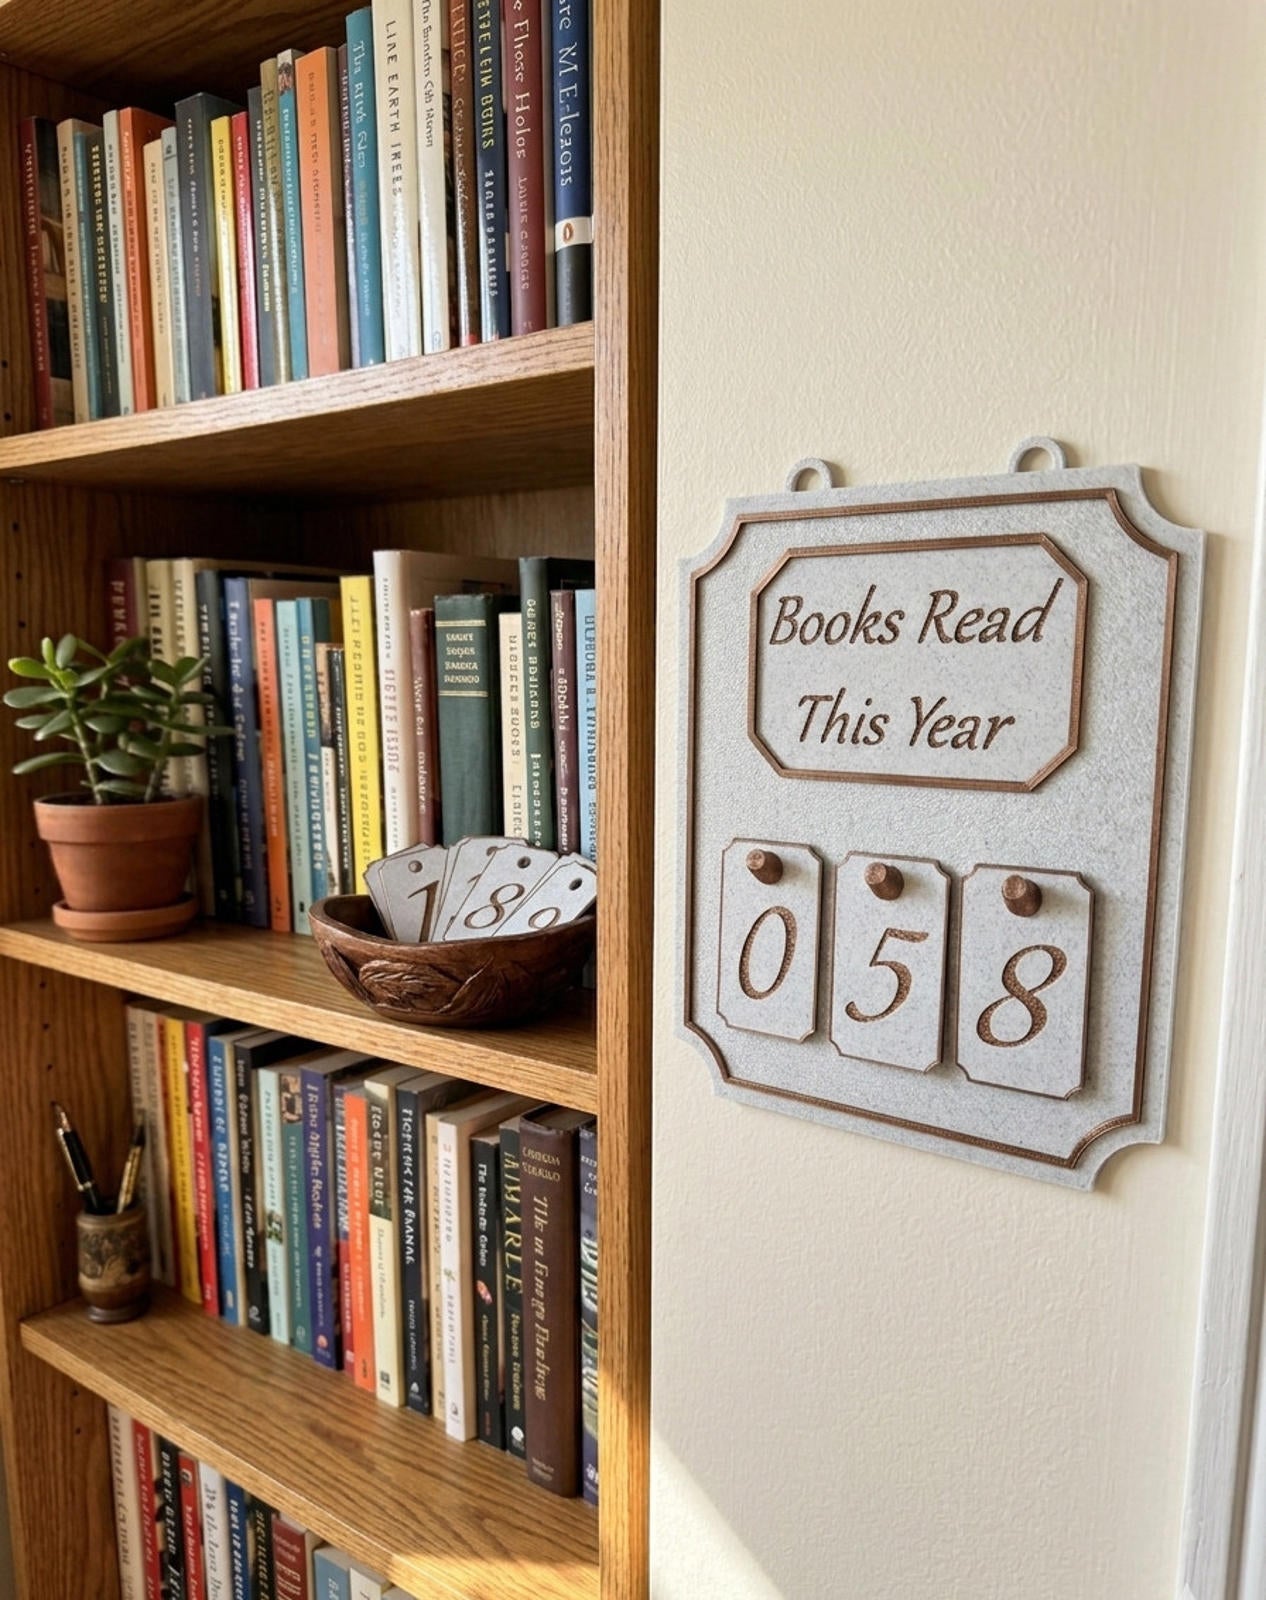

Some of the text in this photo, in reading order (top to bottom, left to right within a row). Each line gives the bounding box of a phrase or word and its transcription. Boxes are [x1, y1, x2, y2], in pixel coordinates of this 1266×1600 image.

[388, 73, 401, 132] EARTH
[769, 578, 1064, 646] Books Read
[798, 687, 1016, 751] This Year
[464, 883, 526, 929] 8
[739, 906, 1067, 1048] 0 5 8
